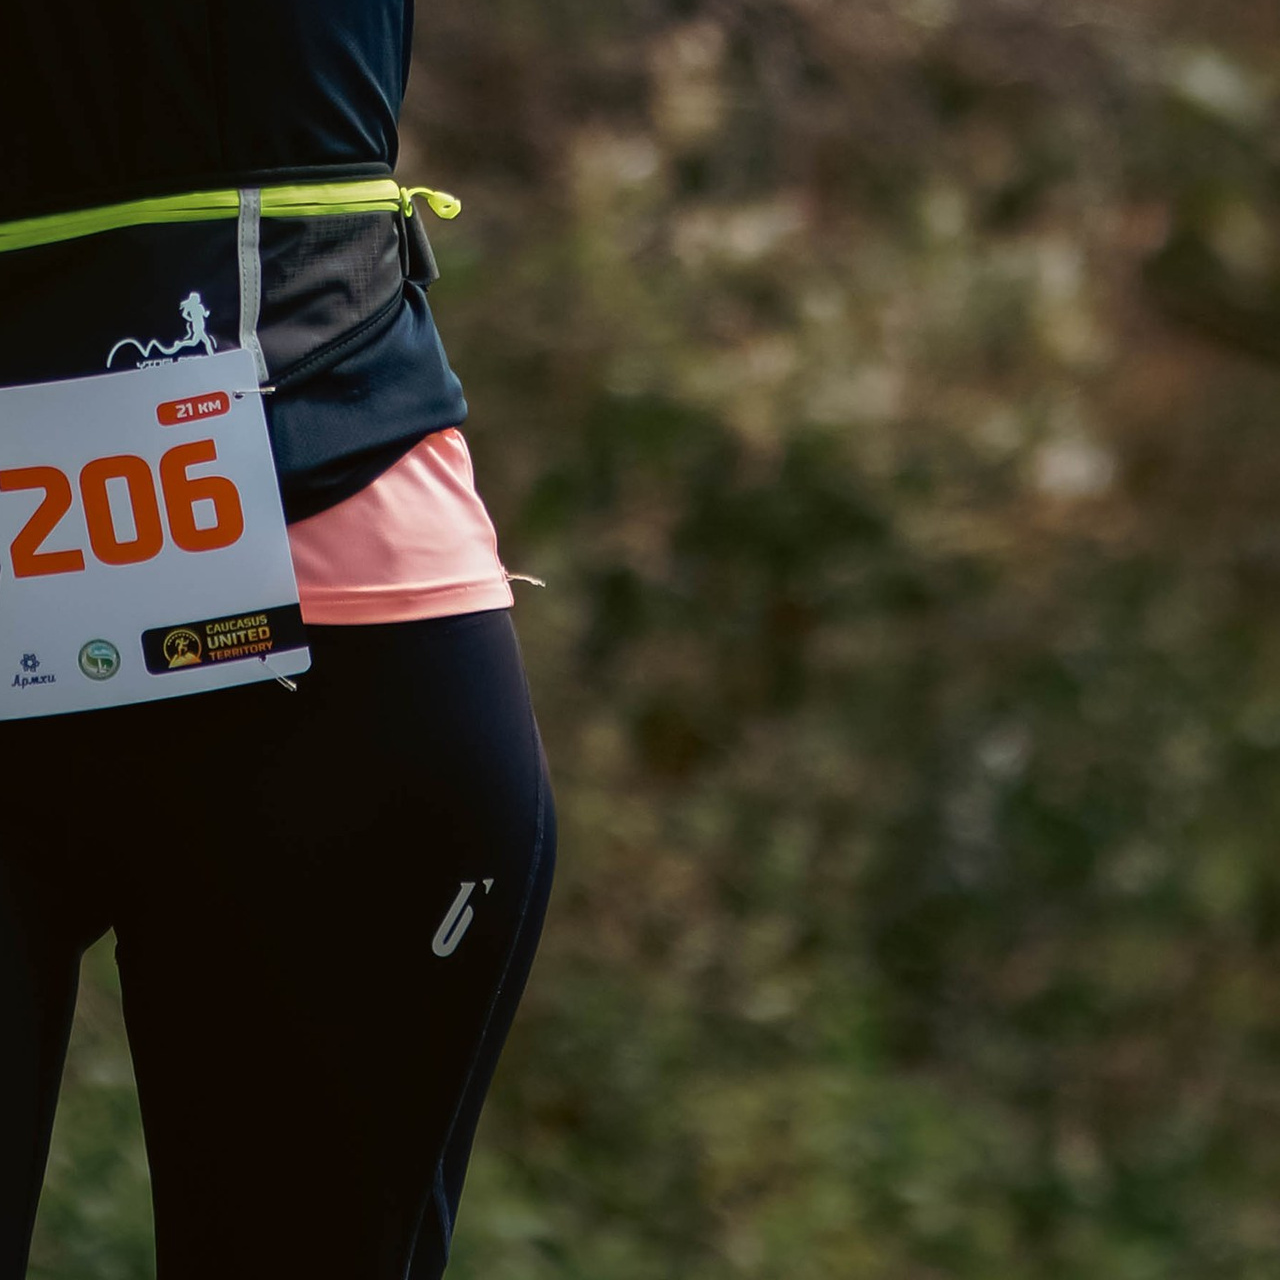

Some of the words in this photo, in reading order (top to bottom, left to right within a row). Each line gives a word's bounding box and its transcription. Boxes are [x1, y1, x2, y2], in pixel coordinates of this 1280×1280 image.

[175, 402, 194, 419] 21
[205, 614, 268, 635] CAUCASUS
[206, 625, 271, 650] UNITED
[208, 640, 273, 661] TERRITORY
[11, 674, 56, 689] Армхи
